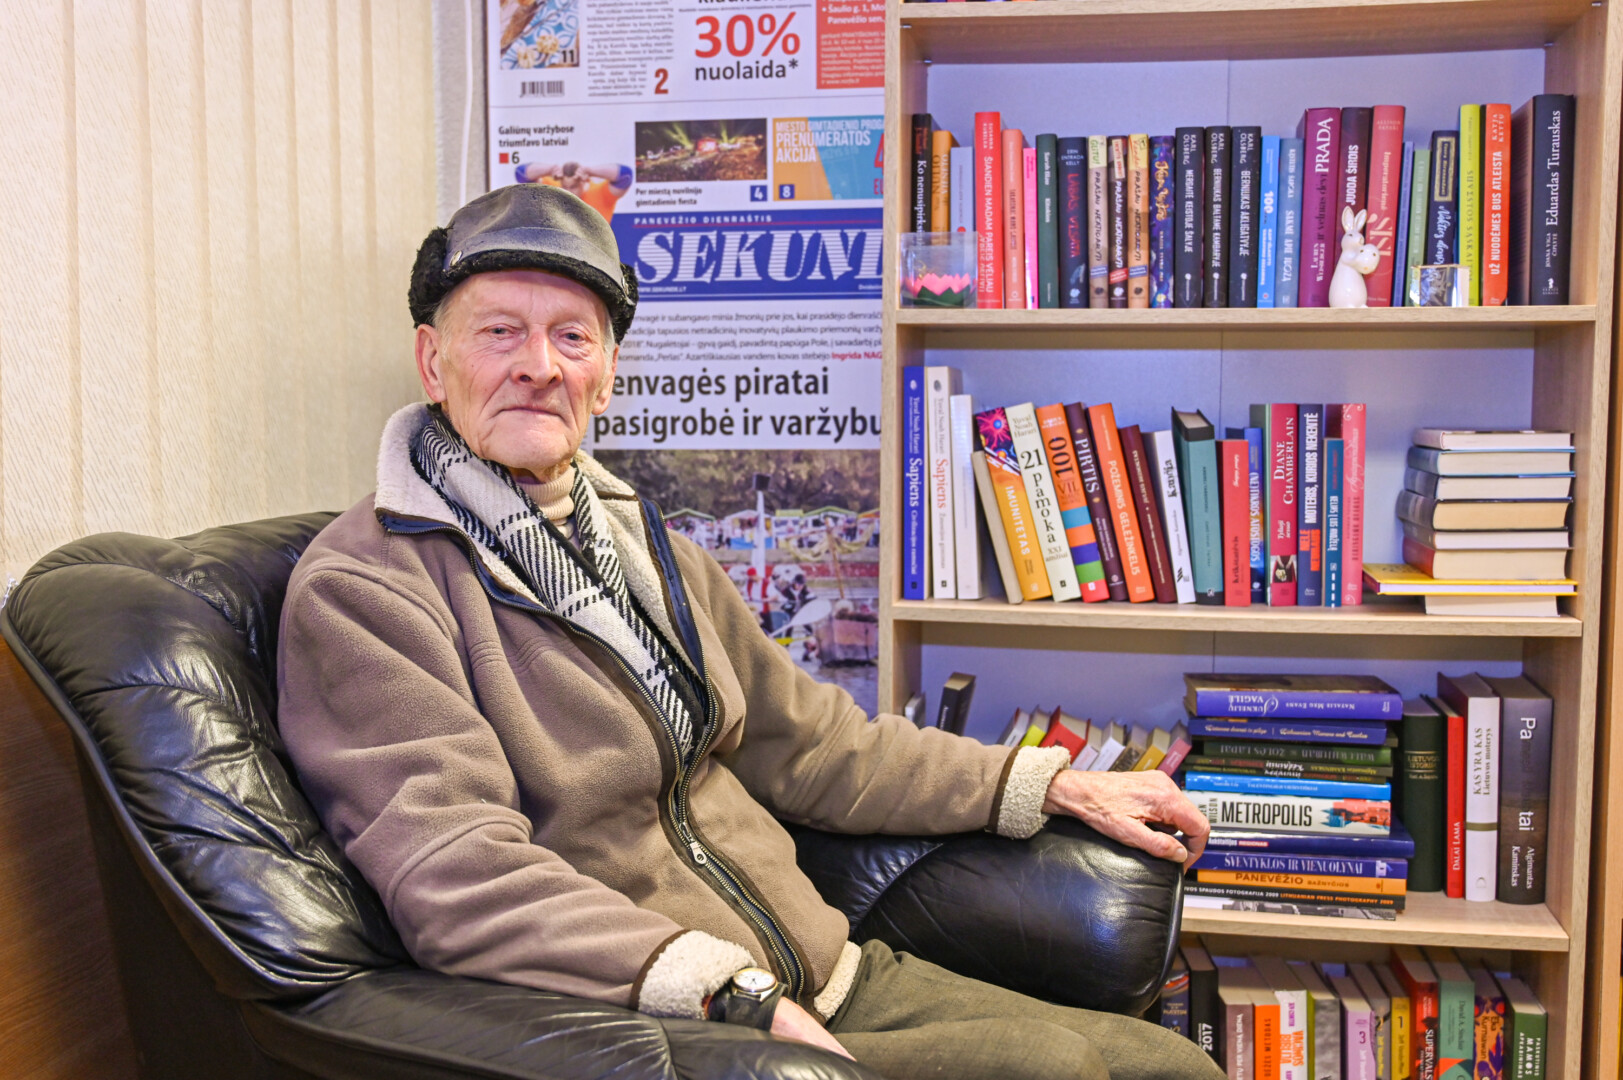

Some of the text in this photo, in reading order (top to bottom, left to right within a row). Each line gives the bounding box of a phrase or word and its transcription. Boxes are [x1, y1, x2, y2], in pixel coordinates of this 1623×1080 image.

[695, 11, 800, 58] 30%
[561, 50, 574, 63] 11
[654, 67, 669, 94] 2
[499, 137, 569, 147] triumfavo latviai
[533, 124, 574, 134] varžybose
[776, 130, 871, 147] PRENUMERATOS
[1315, 117, 1334, 173] PRADA
[511, 151, 520, 164] 6
[776, 147, 817, 162] AKCIJA
[915, 160, 927, 175] Ko
[1546, 111, 1561, 227] Eduardas Turauskas
[782, 186, 791, 198] 8
[1240, 170, 1251, 209] BERNIUKAS
[1345, 144, 1358, 206] JUODA ŠIRDIS
[754, 187, 764, 200] 4
[984, 156, 995, 260] ŠIANDIEN MADAM PAREIS
[1263, 190, 1275, 214] 100
[634, 214, 772, 225] PANEVĖŽIO DIENRAŠTIS
[1489, 152, 1503, 275] UŽ NUODĖMES BUS ATLEISTA
[831, 351, 862, 362] Ingrida
[735, 366, 829, 401] piratai
[594, 407, 763, 443] pasigrobė ir
[912, 433, 920, 454] Harari
[1020, 449, 1044, 470] 21
[1049, 437, 1073, 478] 100
[1273, 441, 1286, 481] DIANE
[1283, 417, 1295, 505] CHAMBERLAIN
[906, 457, 922, 507] Sapiens
[1075, 438, 1100, 493] PIRTIS
[1303, 413, 1319, 524] MOTERIS, KURIOS NEKENTĖ
[932, 458, 948, 509] Sapiens
[1005, 485, 1031, 557] IMUNITETAS
[1108, 460, 1141, 576] POŽEMINIS GELEŽINKELIS
[1473, 727, 1483, 795] KAS YRA KAS
[1483, 727, 1492, 796] Lietuvos moterys
[1519, 717, 1537, 831] Pa tai
[1221, 801, 1313, 827] METROPOLIS
[1224, 851, 1364, 875] ŠVENTYKLOS IR VIENUOLYNAI
[1452, 821, 1461, 871] DALAI LAMA
[1235, 871, 1304, 886] PANEVĖŽIO
[1511, 845, 1520, 887] Kaminskas
[1525, 845, 1535, 889] Algimantas
[1226, 889, 1264, 897] FOTOGRAFIJA
[1202, 1023, 1213, 1051] 2017
[1359, 1031, 1366, 1044] 3
[1397, 1015, 1403, 1029] 1
